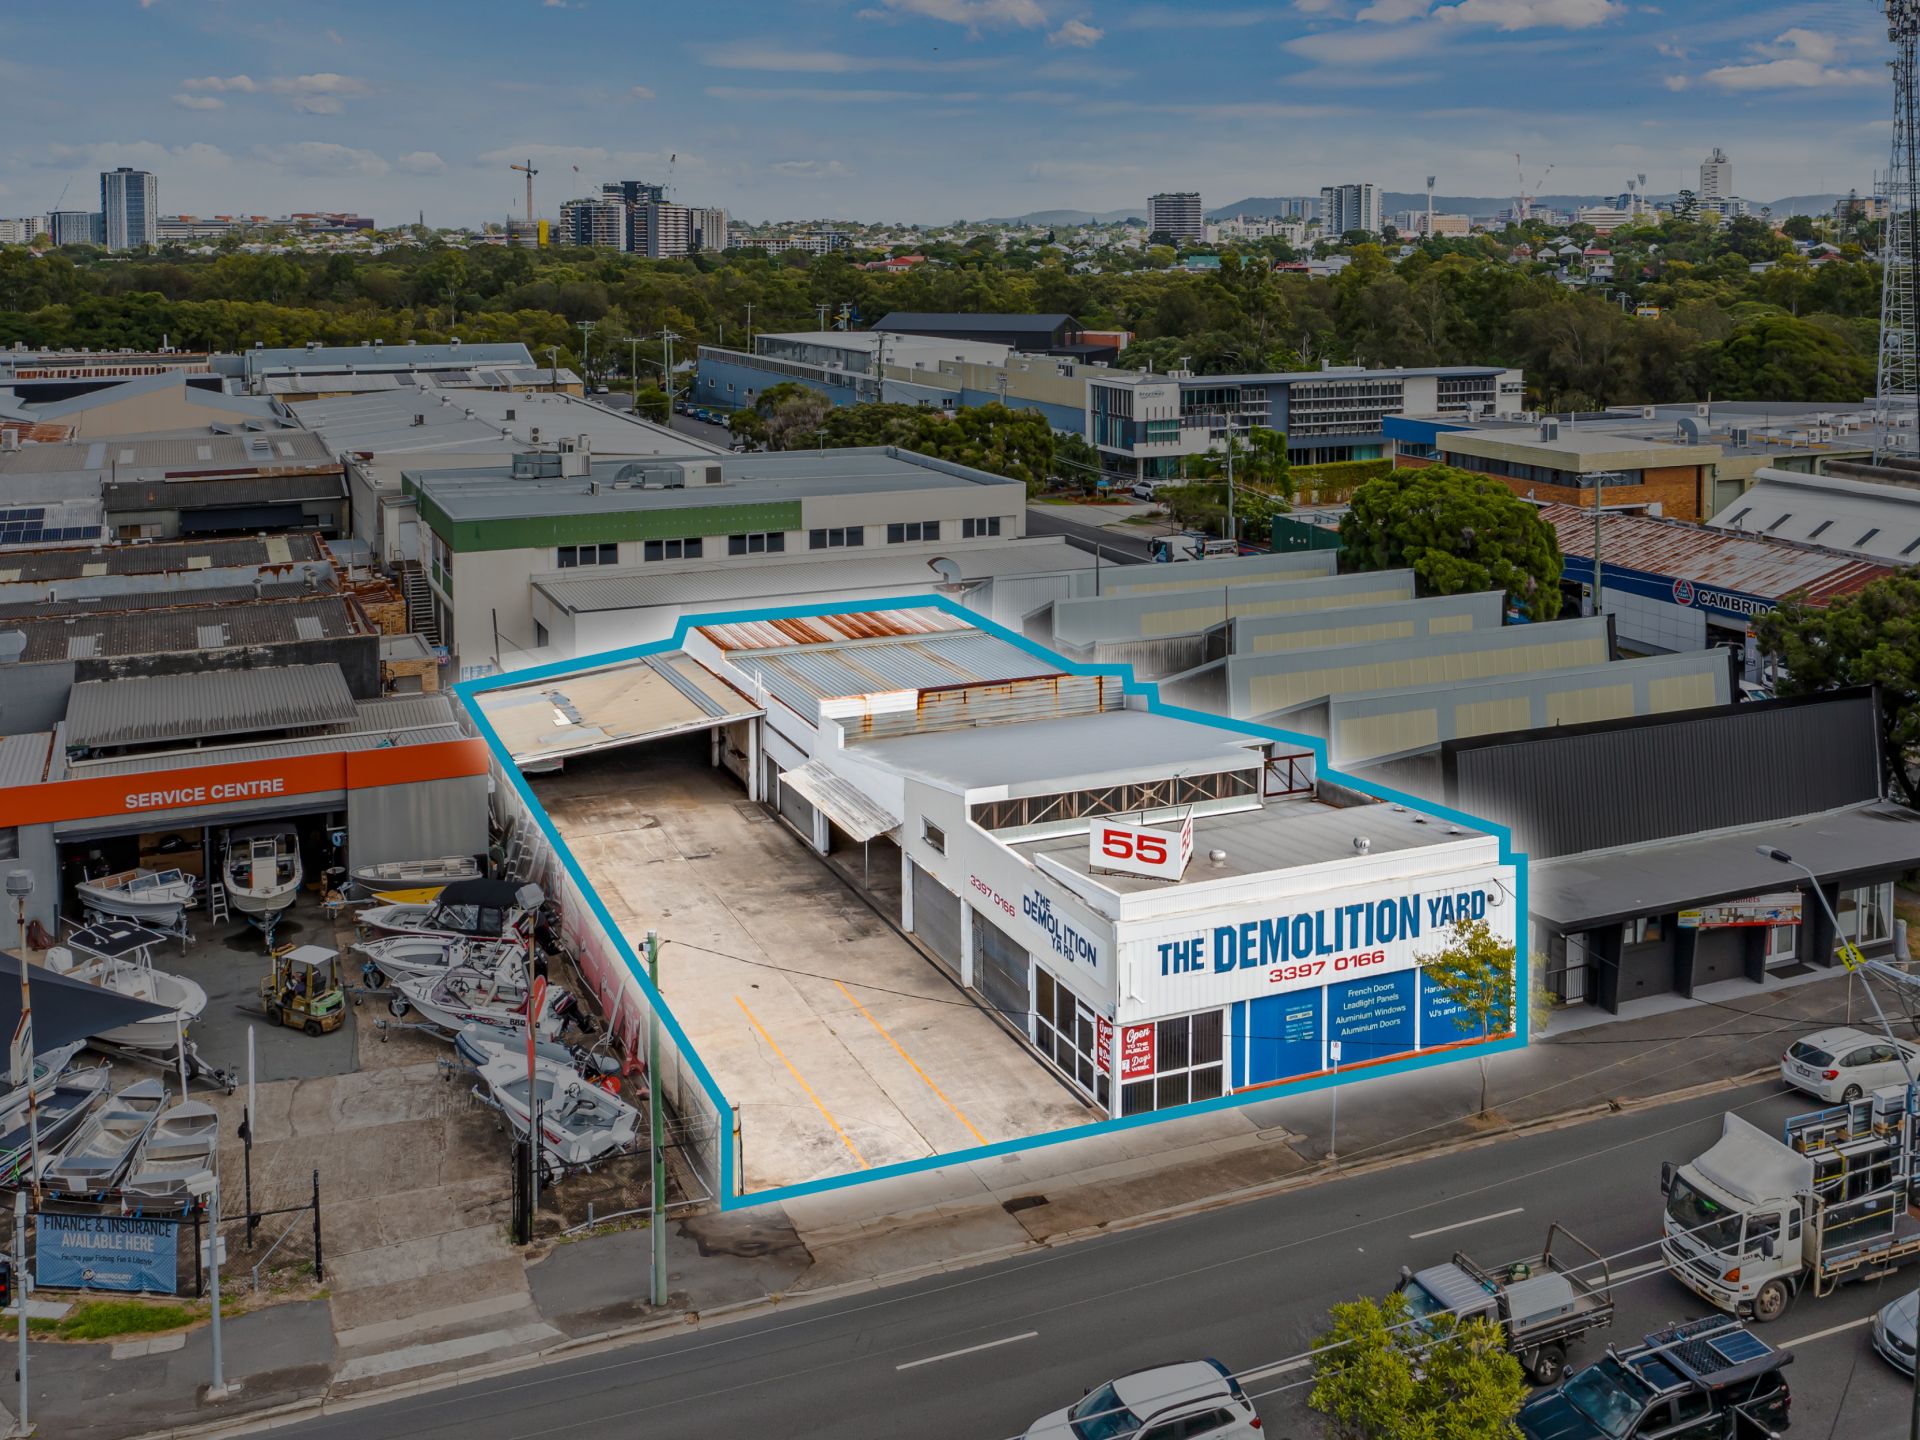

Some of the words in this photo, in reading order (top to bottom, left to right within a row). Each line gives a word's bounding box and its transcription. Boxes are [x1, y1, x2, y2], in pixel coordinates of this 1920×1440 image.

[125, 786, 206, 809] SERVICE
[210, 778, 284, 799] CENTRE
[1103, 828, 1167, 865] 55
[970, 874, 993, 898] 3397
[994, 893, 1016, 917] 0166
[1034, 889, 1051, 912] THE
[1023, 894, 1097, 968] DEMOLITION
[1158, 937, 1205, 976] THE
[1213, 893, 1420, 974] DEMOLITION
[1427, 889, 1486, 928] YARD
[1051, 935, 1075, 962] YARD
[1269, 961, 1326, 983] 3397
[1334, 950, 1385, 971] 0166
[1348, 986, 1372, 997] French
[1373, 983, 1395, 992] Doors
[1343, 998, 1375, 1010] Leadlight
[1376, 993, 1399, 1004] Panels
[1443, 1006, 1456, 1015] and
[1335, 1012, 1373, 1024] Aluminium
[1374, 1005, 1406, 1016] Windows
[1126, 1028, 1151, 1044] Open
[1341, 1023, 1378, 1036] Aluminium
[1379, 1018, 1401, 1028] Doors
[1125, 1046, 1149, 1055] PUBLIC
[1131, 1053, 1151, 1067] Days
[1131, 1064, 1150, 1072] WEEK
[43, 1214, 93, 1232] FINANCE
[95, 1219, 105, 1232] &
[107, 1219, 171, 1238] INSURANCE
[62, 1232, 122, 1250] AVAILABLE
[125, 1236, 155, 1252] HERE
